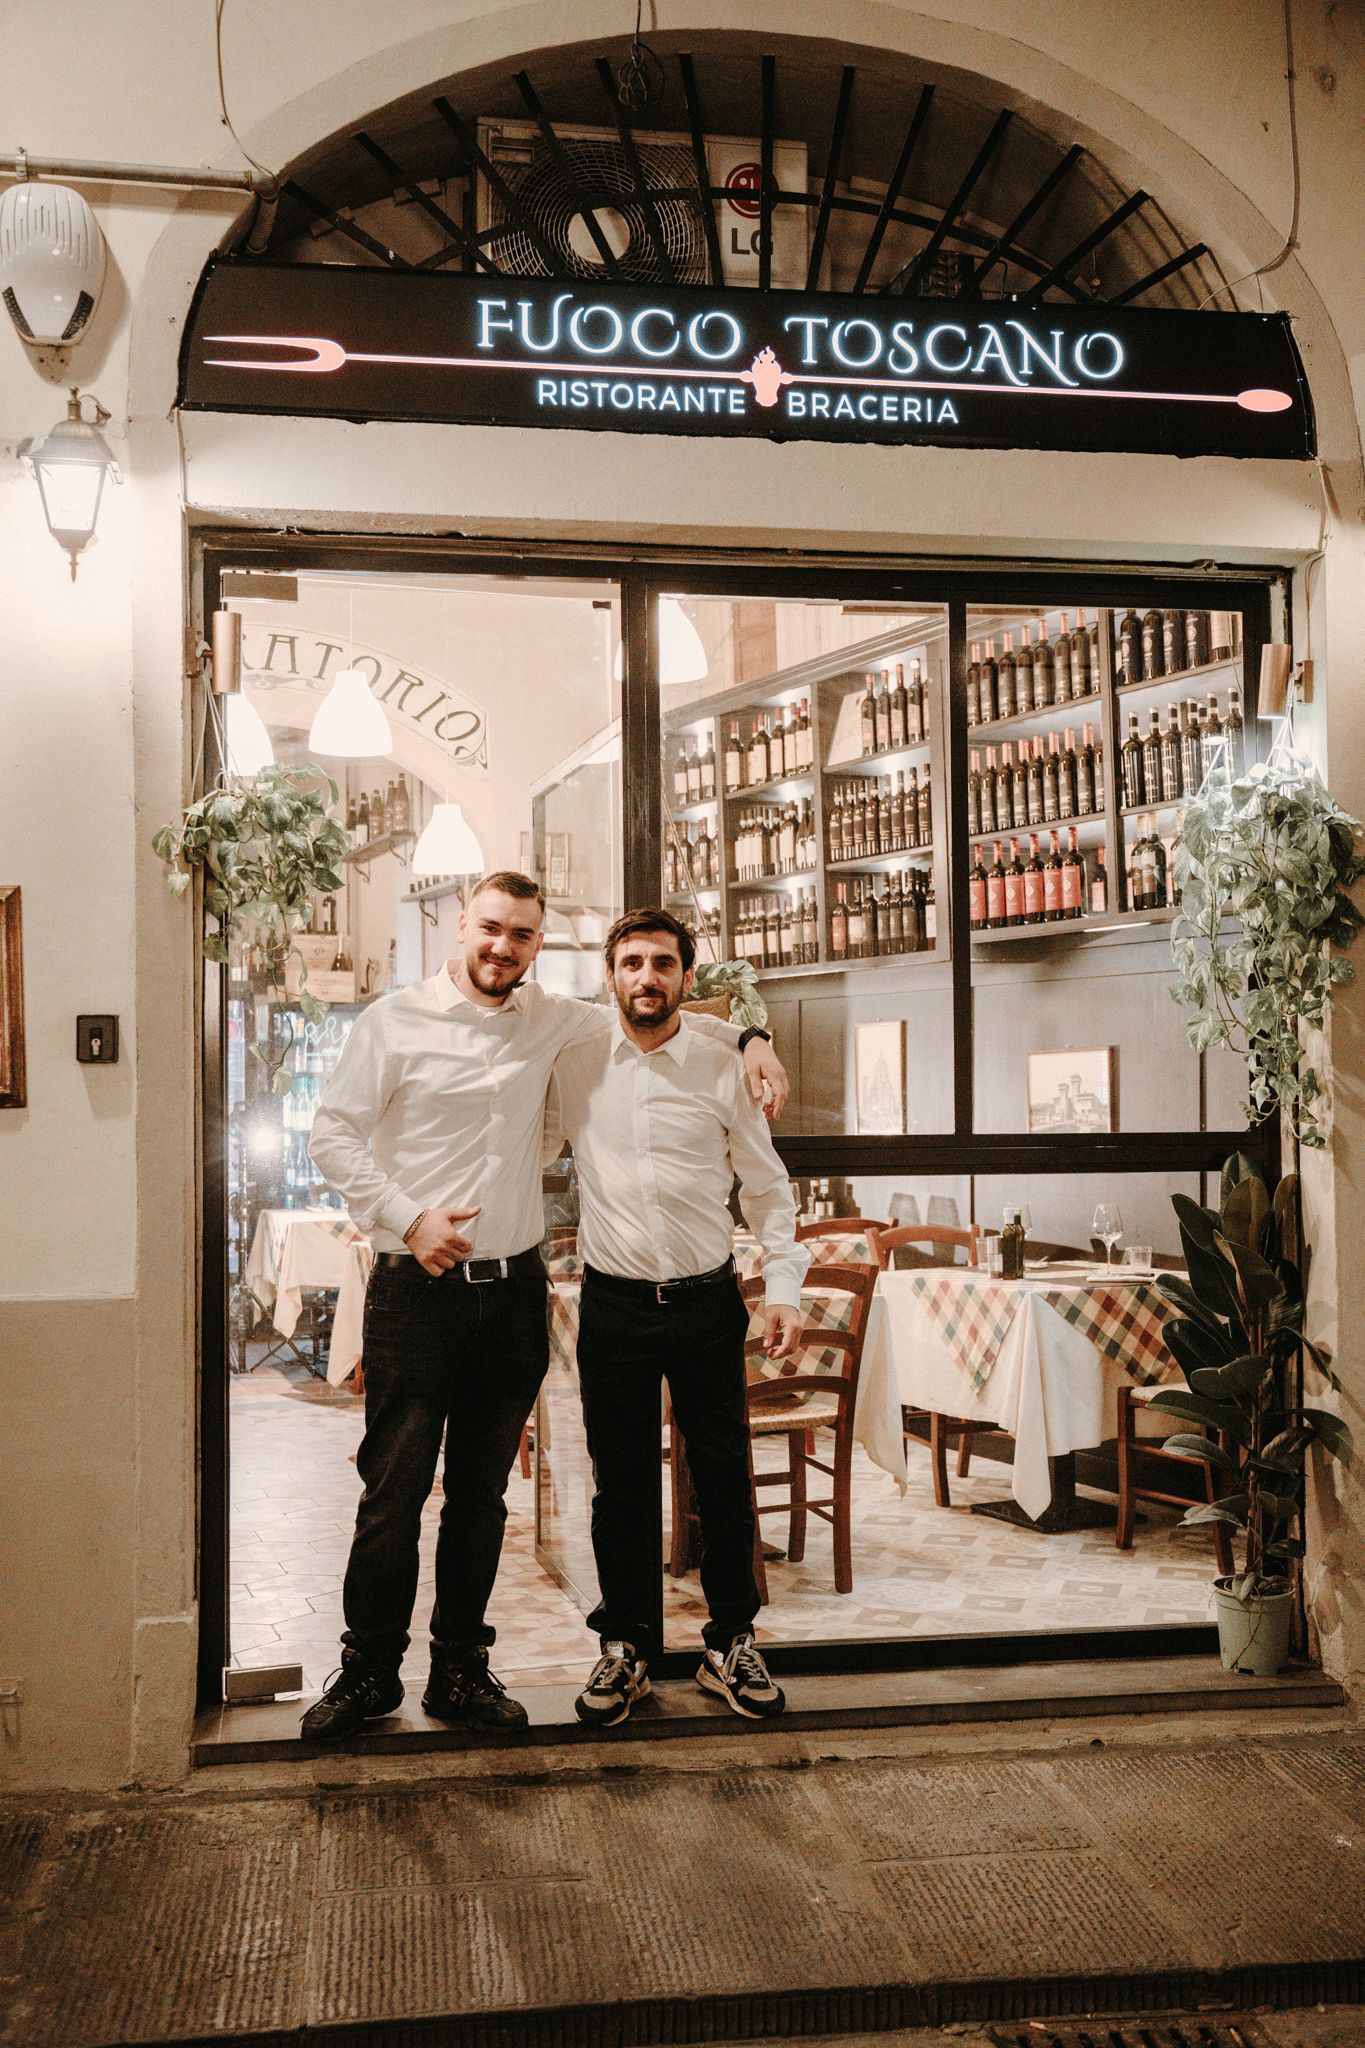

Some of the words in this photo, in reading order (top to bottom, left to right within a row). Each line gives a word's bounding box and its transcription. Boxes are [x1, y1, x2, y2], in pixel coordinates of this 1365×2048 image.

[476, 293, 743, 360] FUOCO
[784, 314, 1124, 387] TOSCANO
[537, 379, 746, 415] RISTORANTE
[786, 391, 960, 425] BRACERIA
[242, 633, 482, 742] ATORIO
